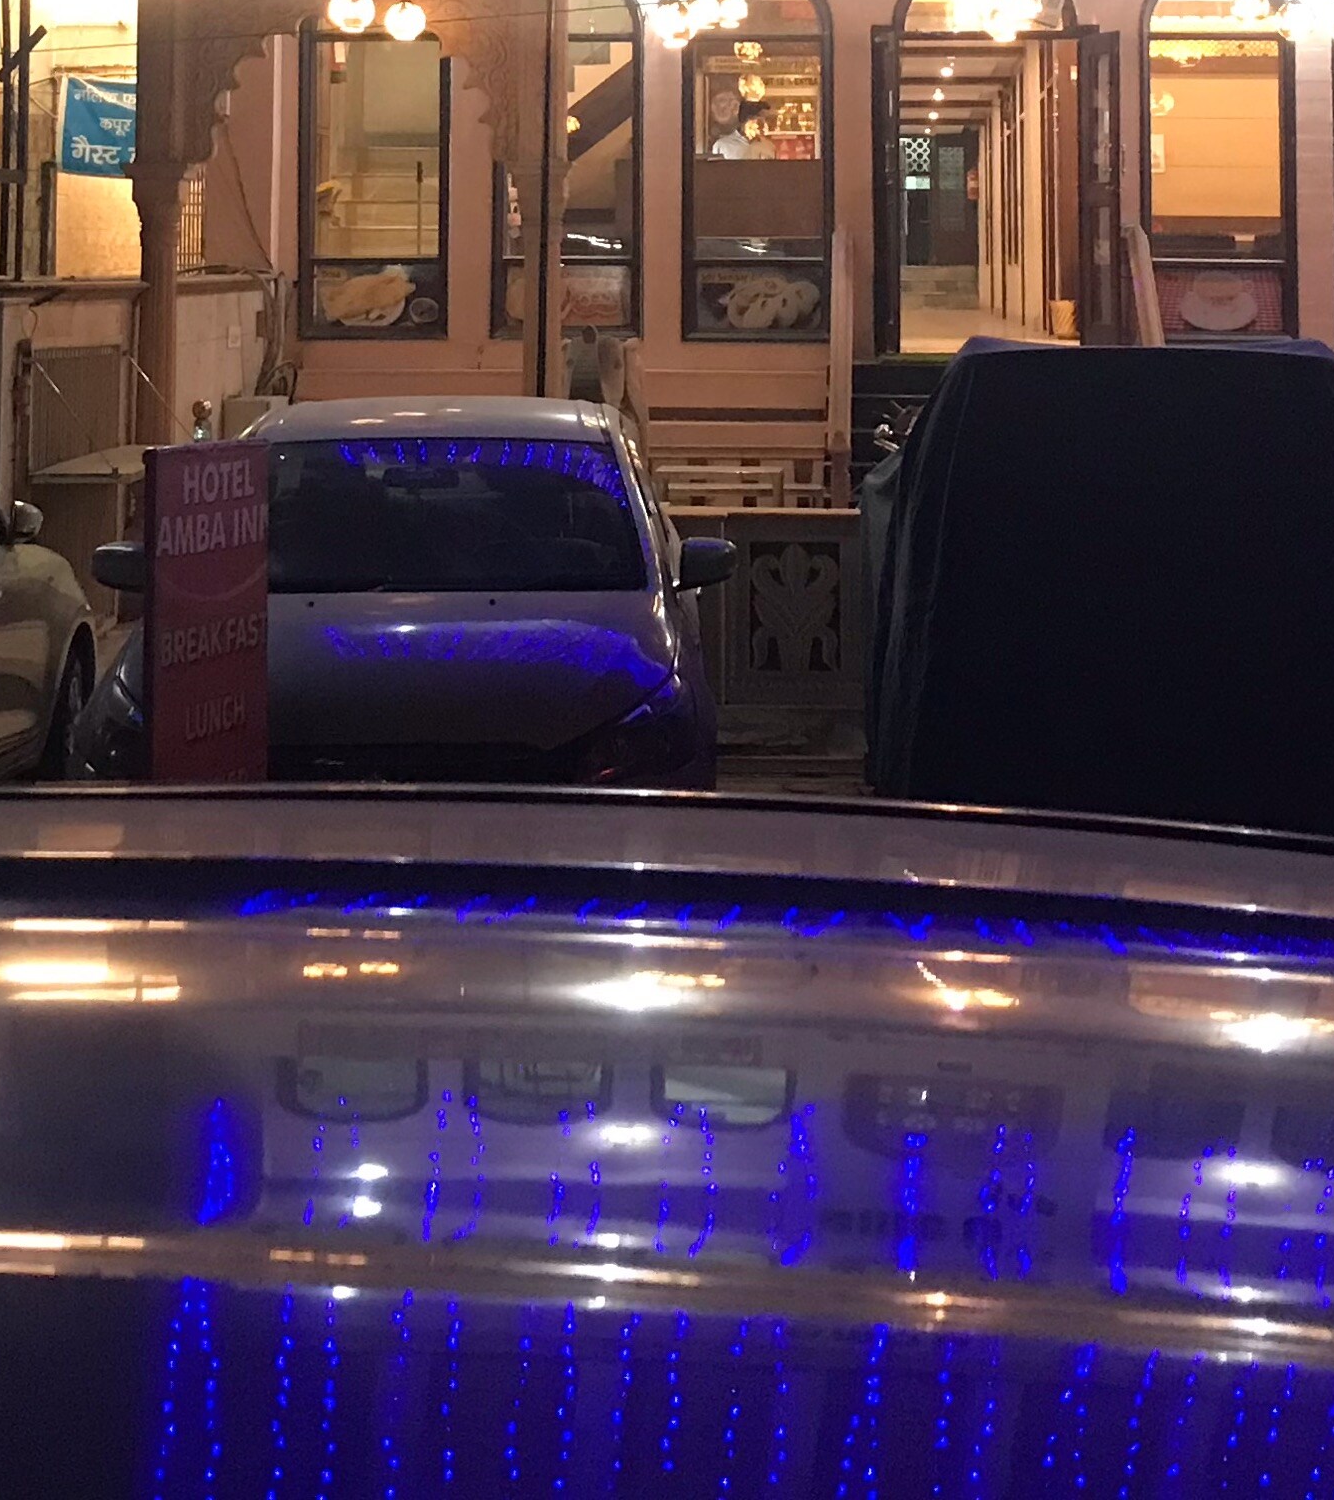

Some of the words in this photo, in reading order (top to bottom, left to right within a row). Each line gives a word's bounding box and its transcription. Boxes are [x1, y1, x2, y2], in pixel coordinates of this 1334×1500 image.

[99, 117, 133, 136] कपूर
[182, 458, 255, 505] HOTEL
[156, 510, 228, 558] AMBA
[184, 692, 247, 742] LUNCH
